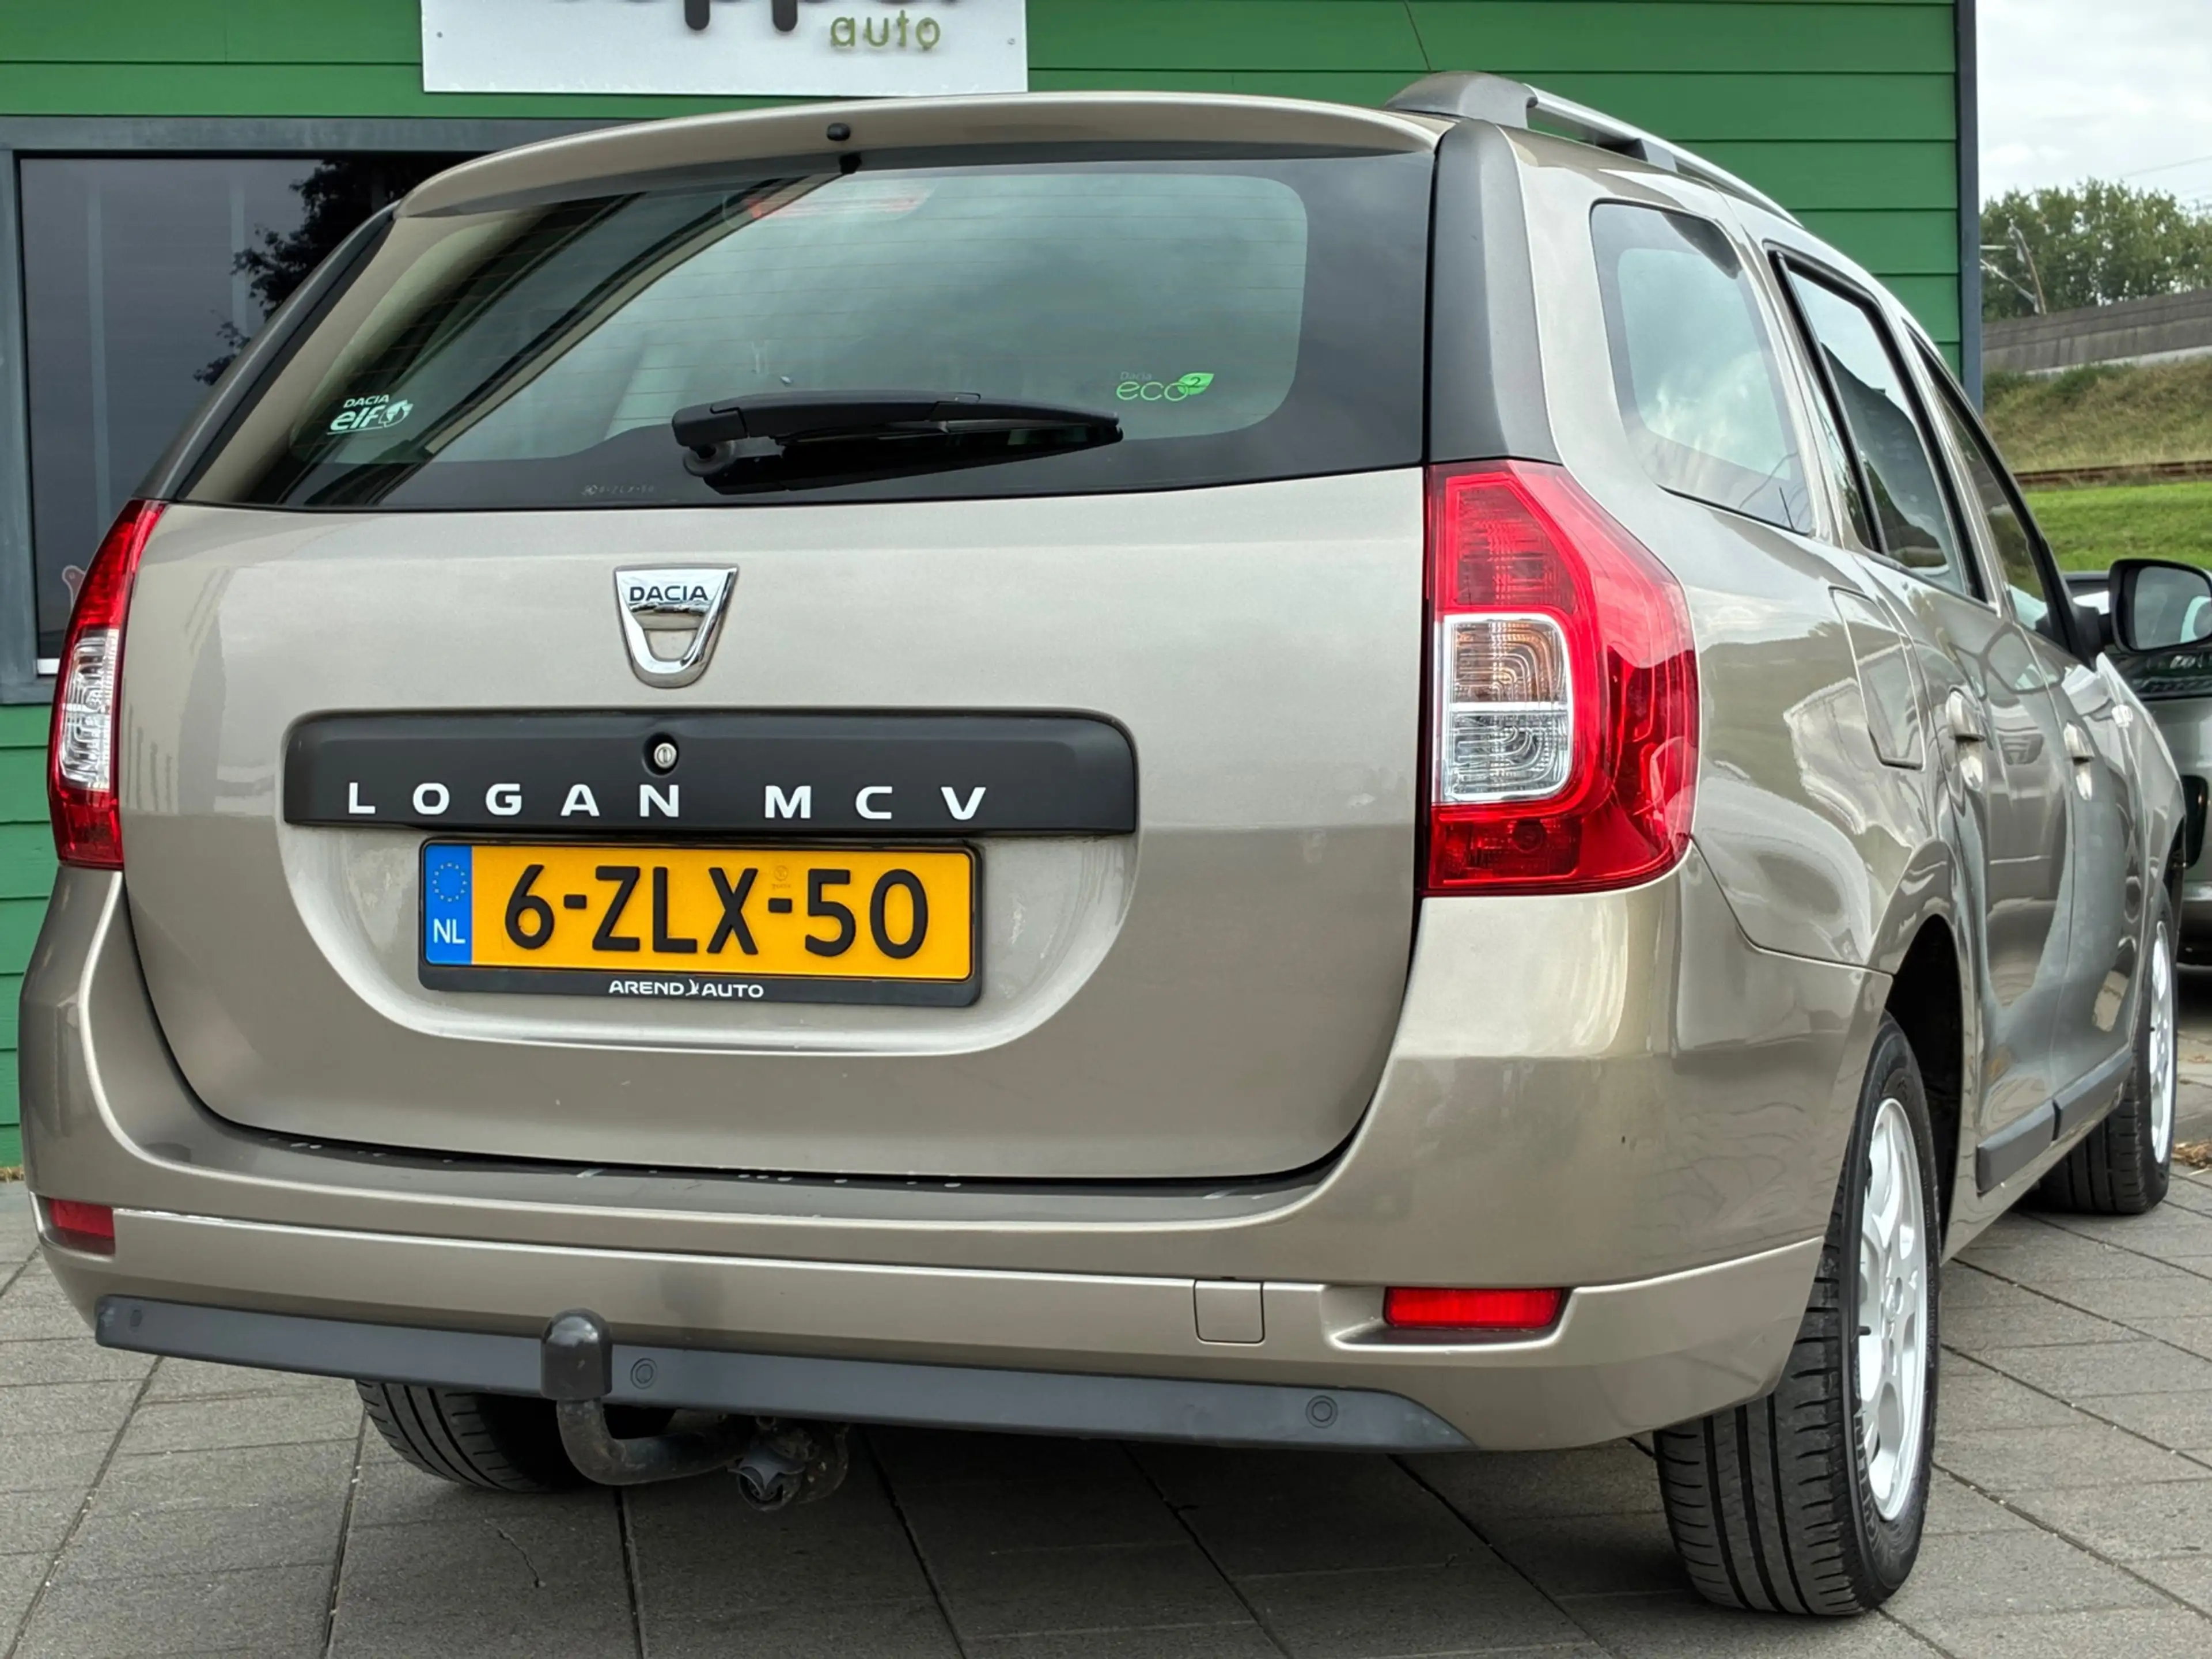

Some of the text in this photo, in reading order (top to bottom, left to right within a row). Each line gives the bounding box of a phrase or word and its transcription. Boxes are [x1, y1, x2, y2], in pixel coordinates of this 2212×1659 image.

[830, 9, 941, 51] auto
[343, 394, 389, 408] DACIA
[329, 405, 386, 431] elf
[629, 585, 709, 602] DACIA
[349, 782, 987, 820] LOGAN MCV
[505, 863, 929, 960] 6-ZLX-50
[433, 918, 466, 944] NL
[608, 980, 764, 998] AREND AUTO
